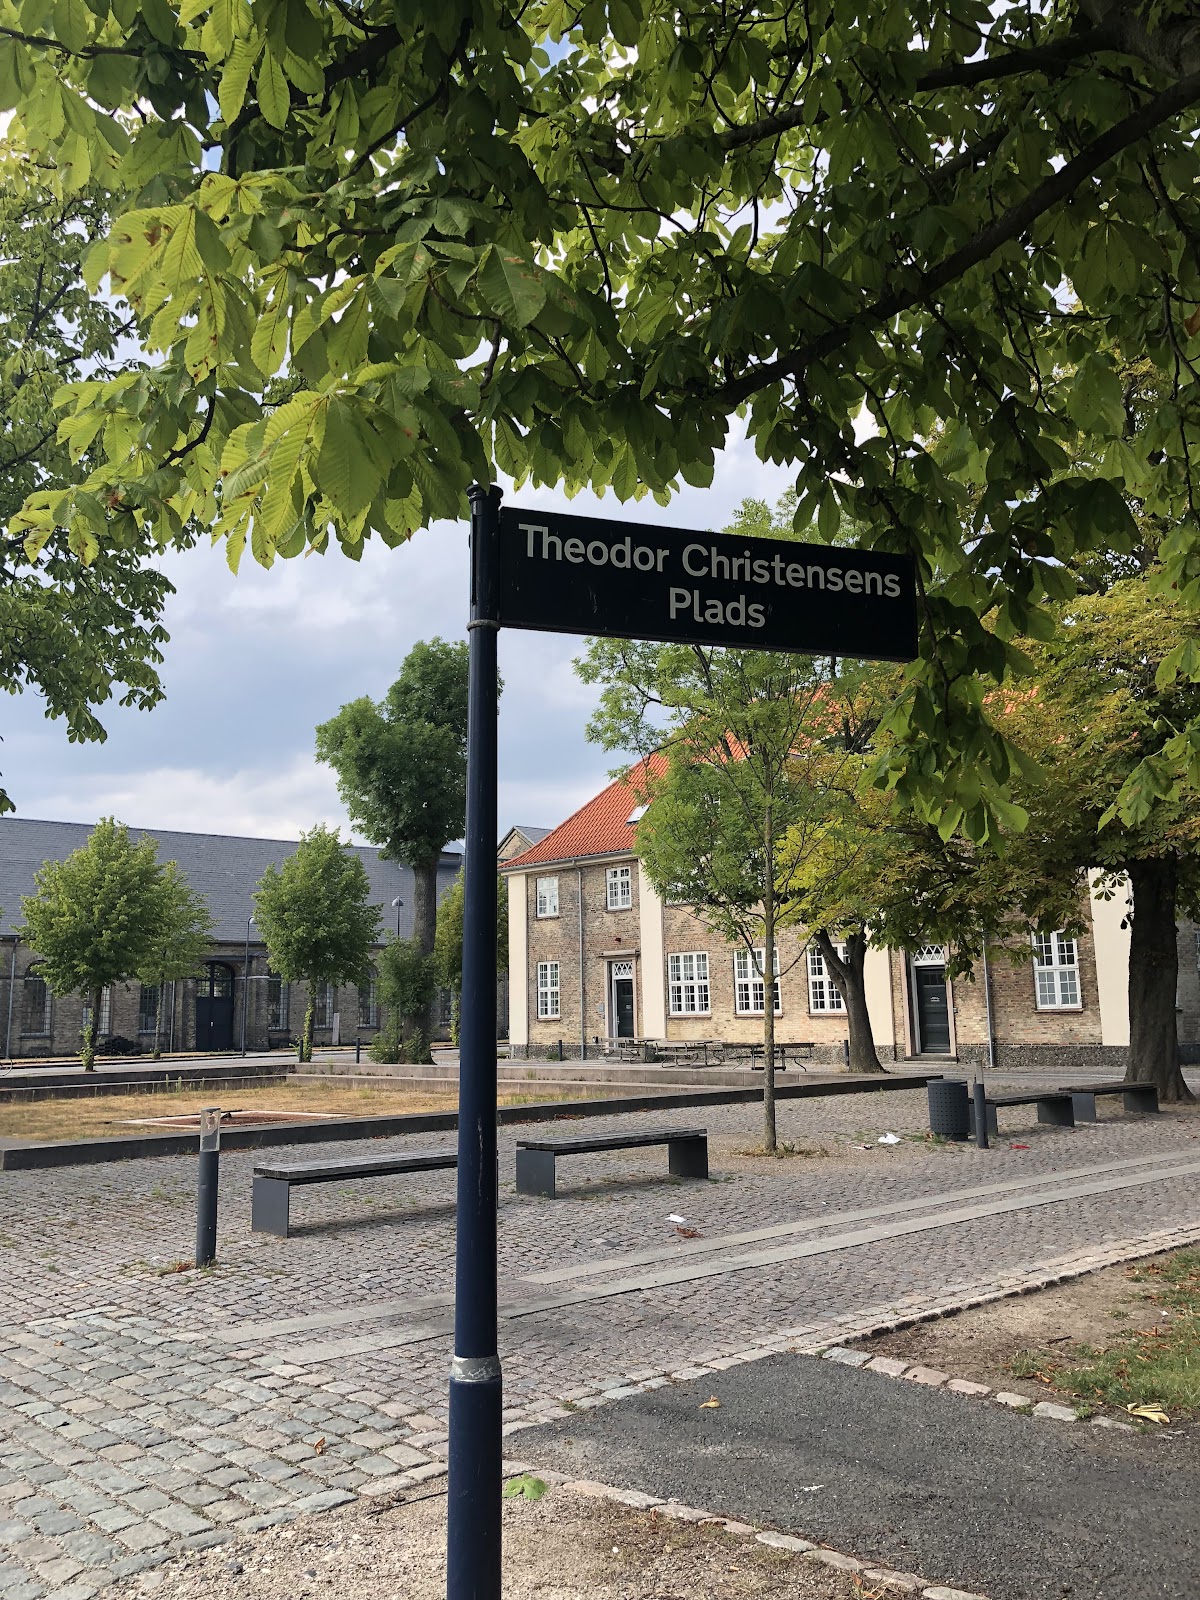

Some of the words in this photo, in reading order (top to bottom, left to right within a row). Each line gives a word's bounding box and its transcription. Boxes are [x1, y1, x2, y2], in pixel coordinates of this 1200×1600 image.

[518, 523, 669, 572] Theodor
[682, 544, 901, 598] Christensens
[669, 587, 766, 628] Plads
